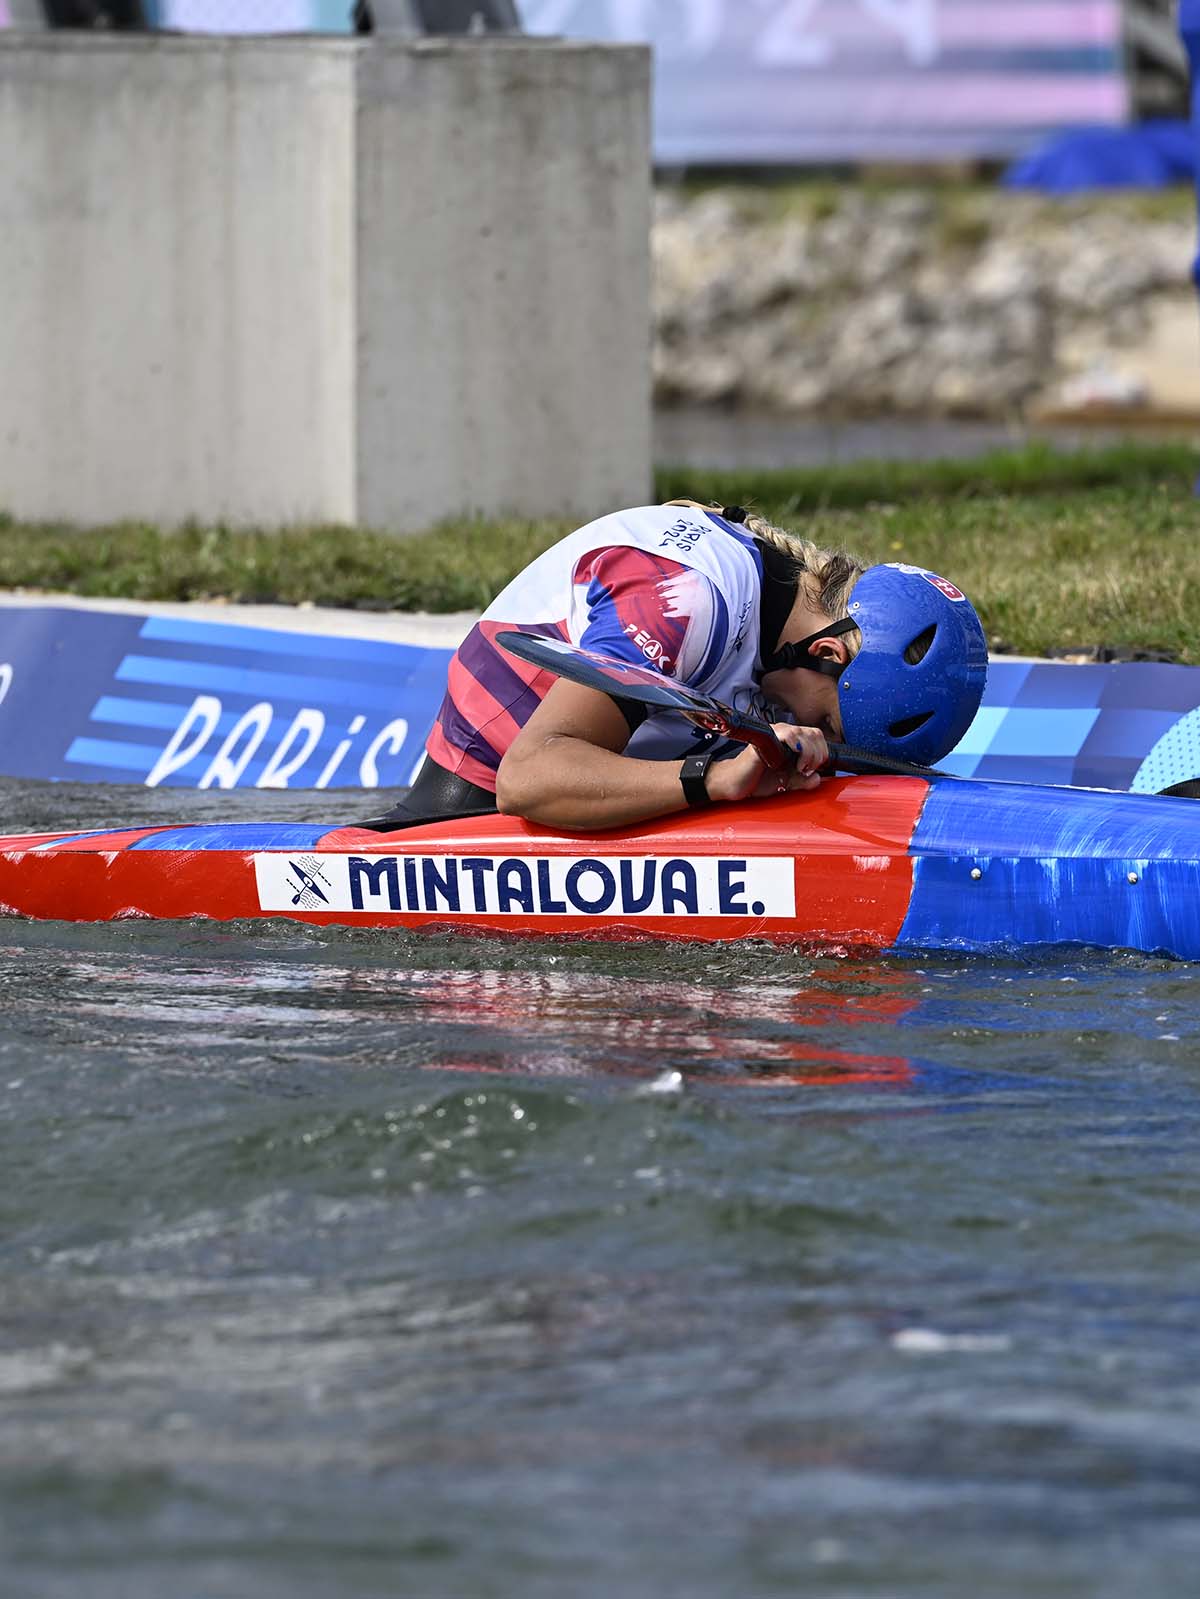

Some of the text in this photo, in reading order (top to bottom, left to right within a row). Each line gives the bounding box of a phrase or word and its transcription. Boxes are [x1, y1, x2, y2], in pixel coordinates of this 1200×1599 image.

[658, 519, 694, 547] 2024
[348, 857, 766, 916] MINTALOVA E.
